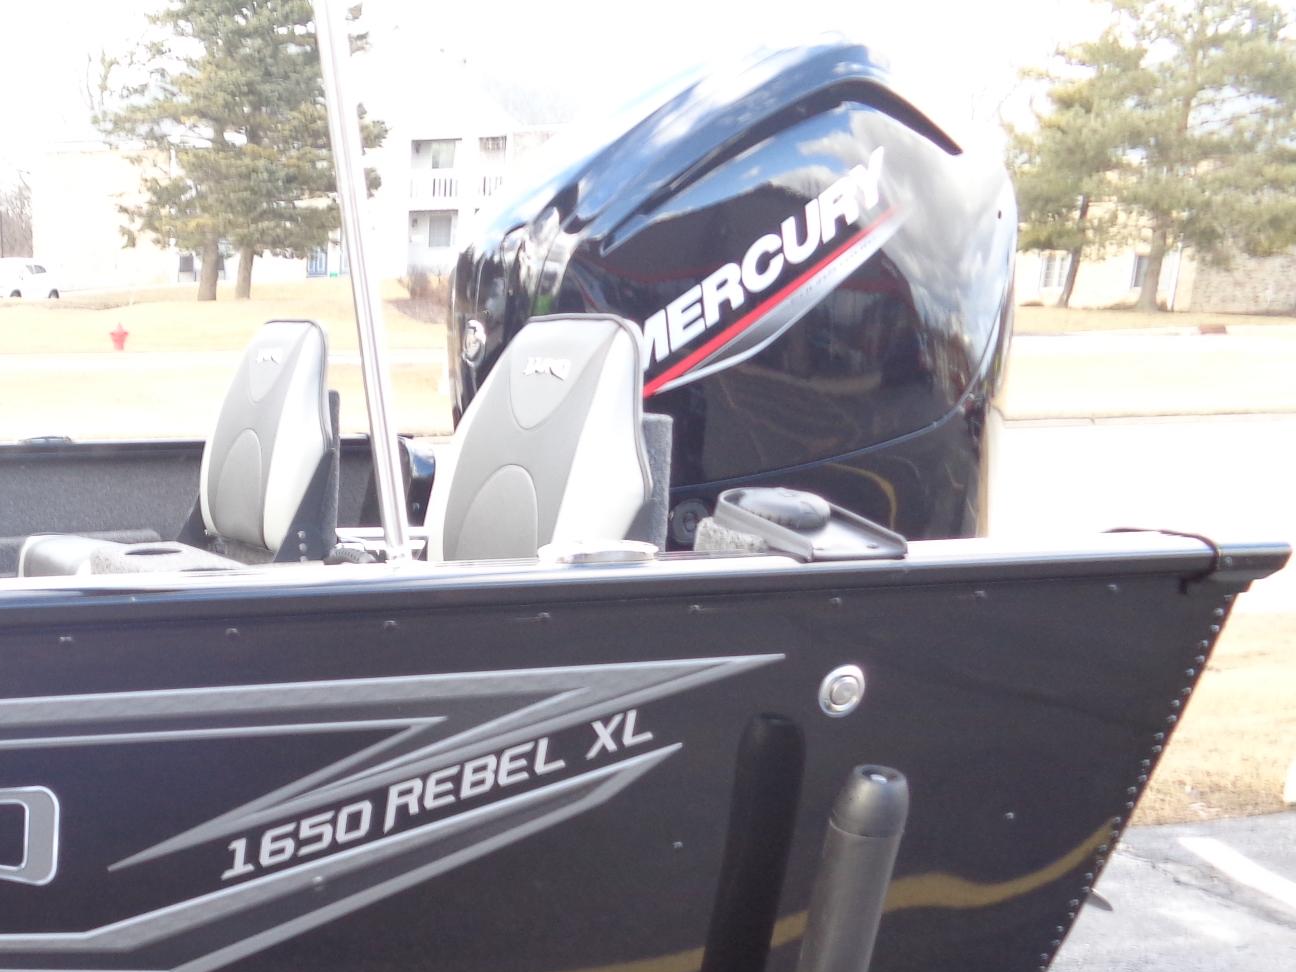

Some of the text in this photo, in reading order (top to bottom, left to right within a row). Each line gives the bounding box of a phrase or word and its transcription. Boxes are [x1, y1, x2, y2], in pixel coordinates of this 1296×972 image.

[221, 709, 654, 880] 1650 REBEL XL
